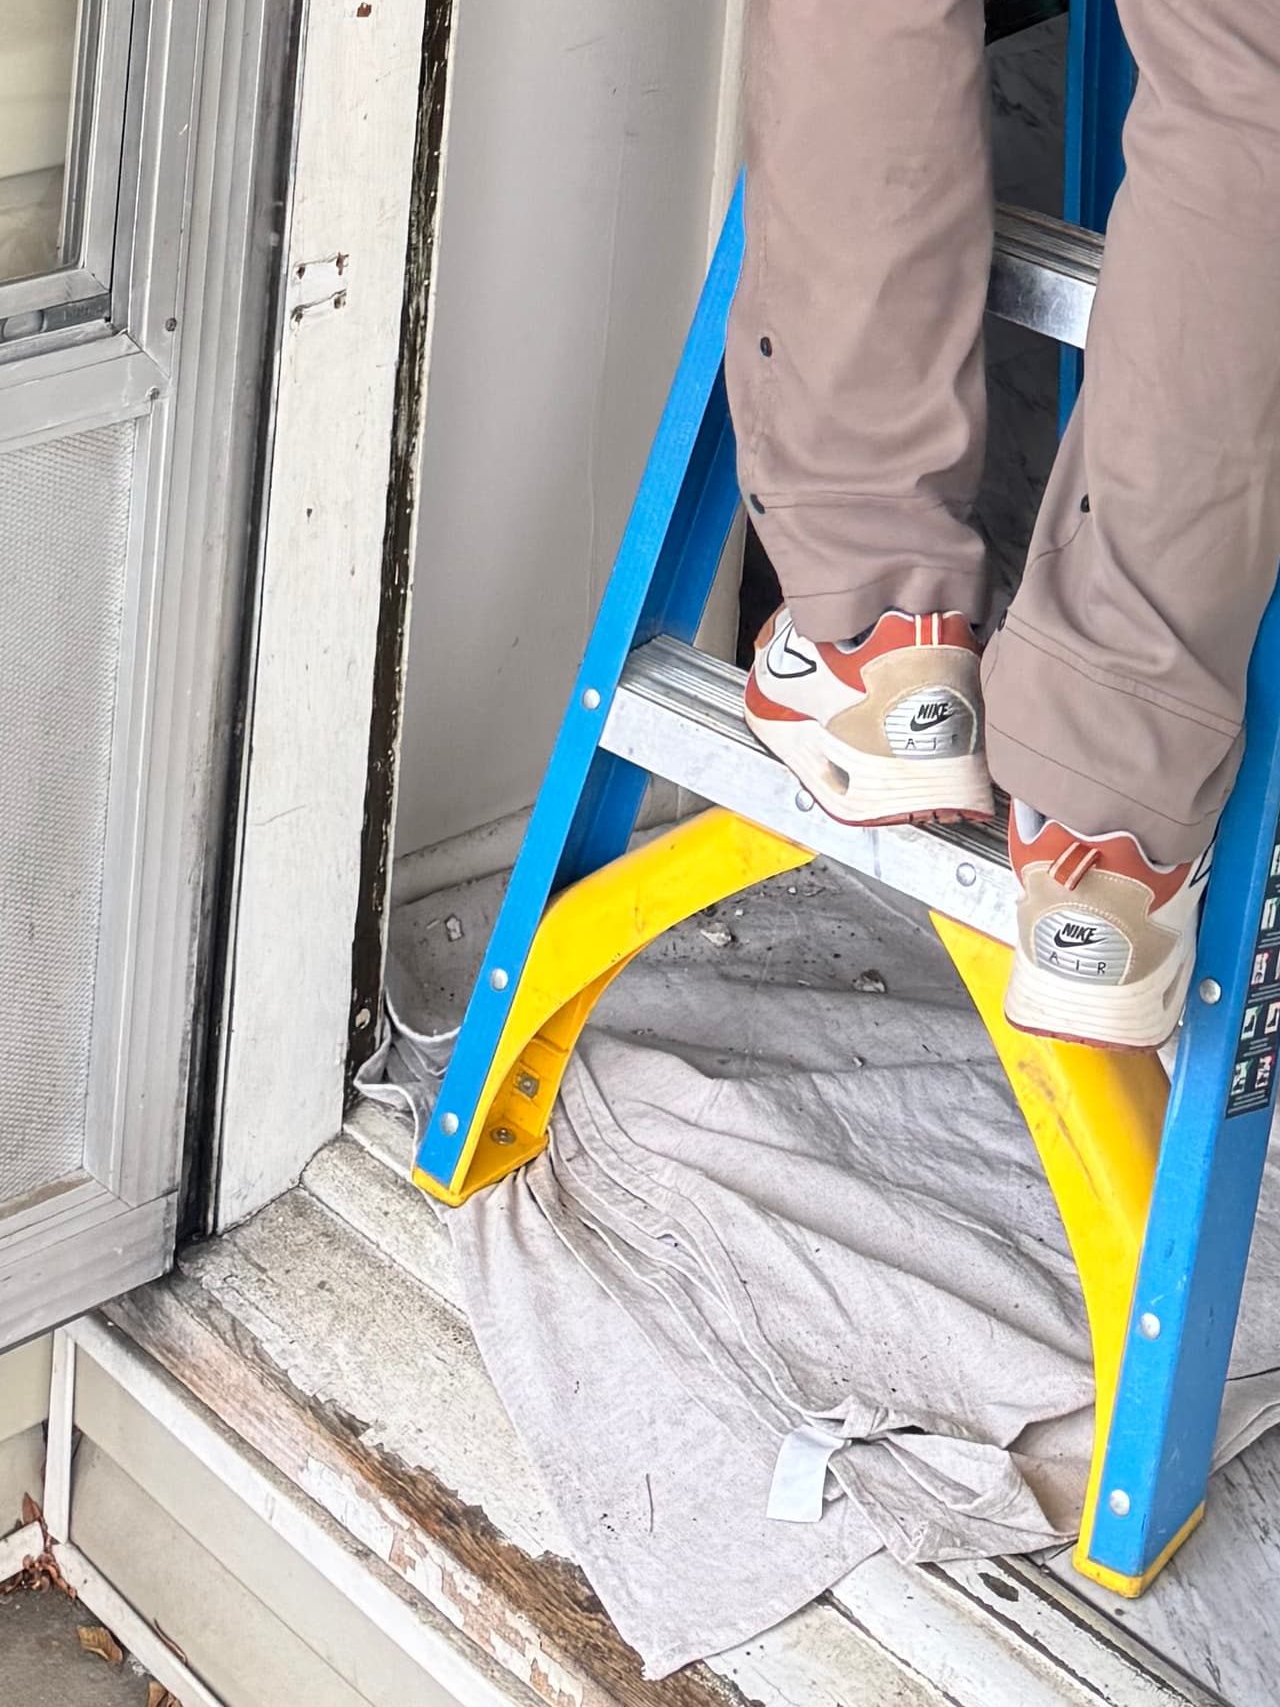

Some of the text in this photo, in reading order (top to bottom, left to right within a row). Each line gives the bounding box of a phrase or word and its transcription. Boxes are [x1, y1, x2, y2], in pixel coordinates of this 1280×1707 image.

[917, 702, 952, 720] NIKE
[1061, 921, 1099, 942] NIKE
[1049, 950, 1108, 976] AIR
